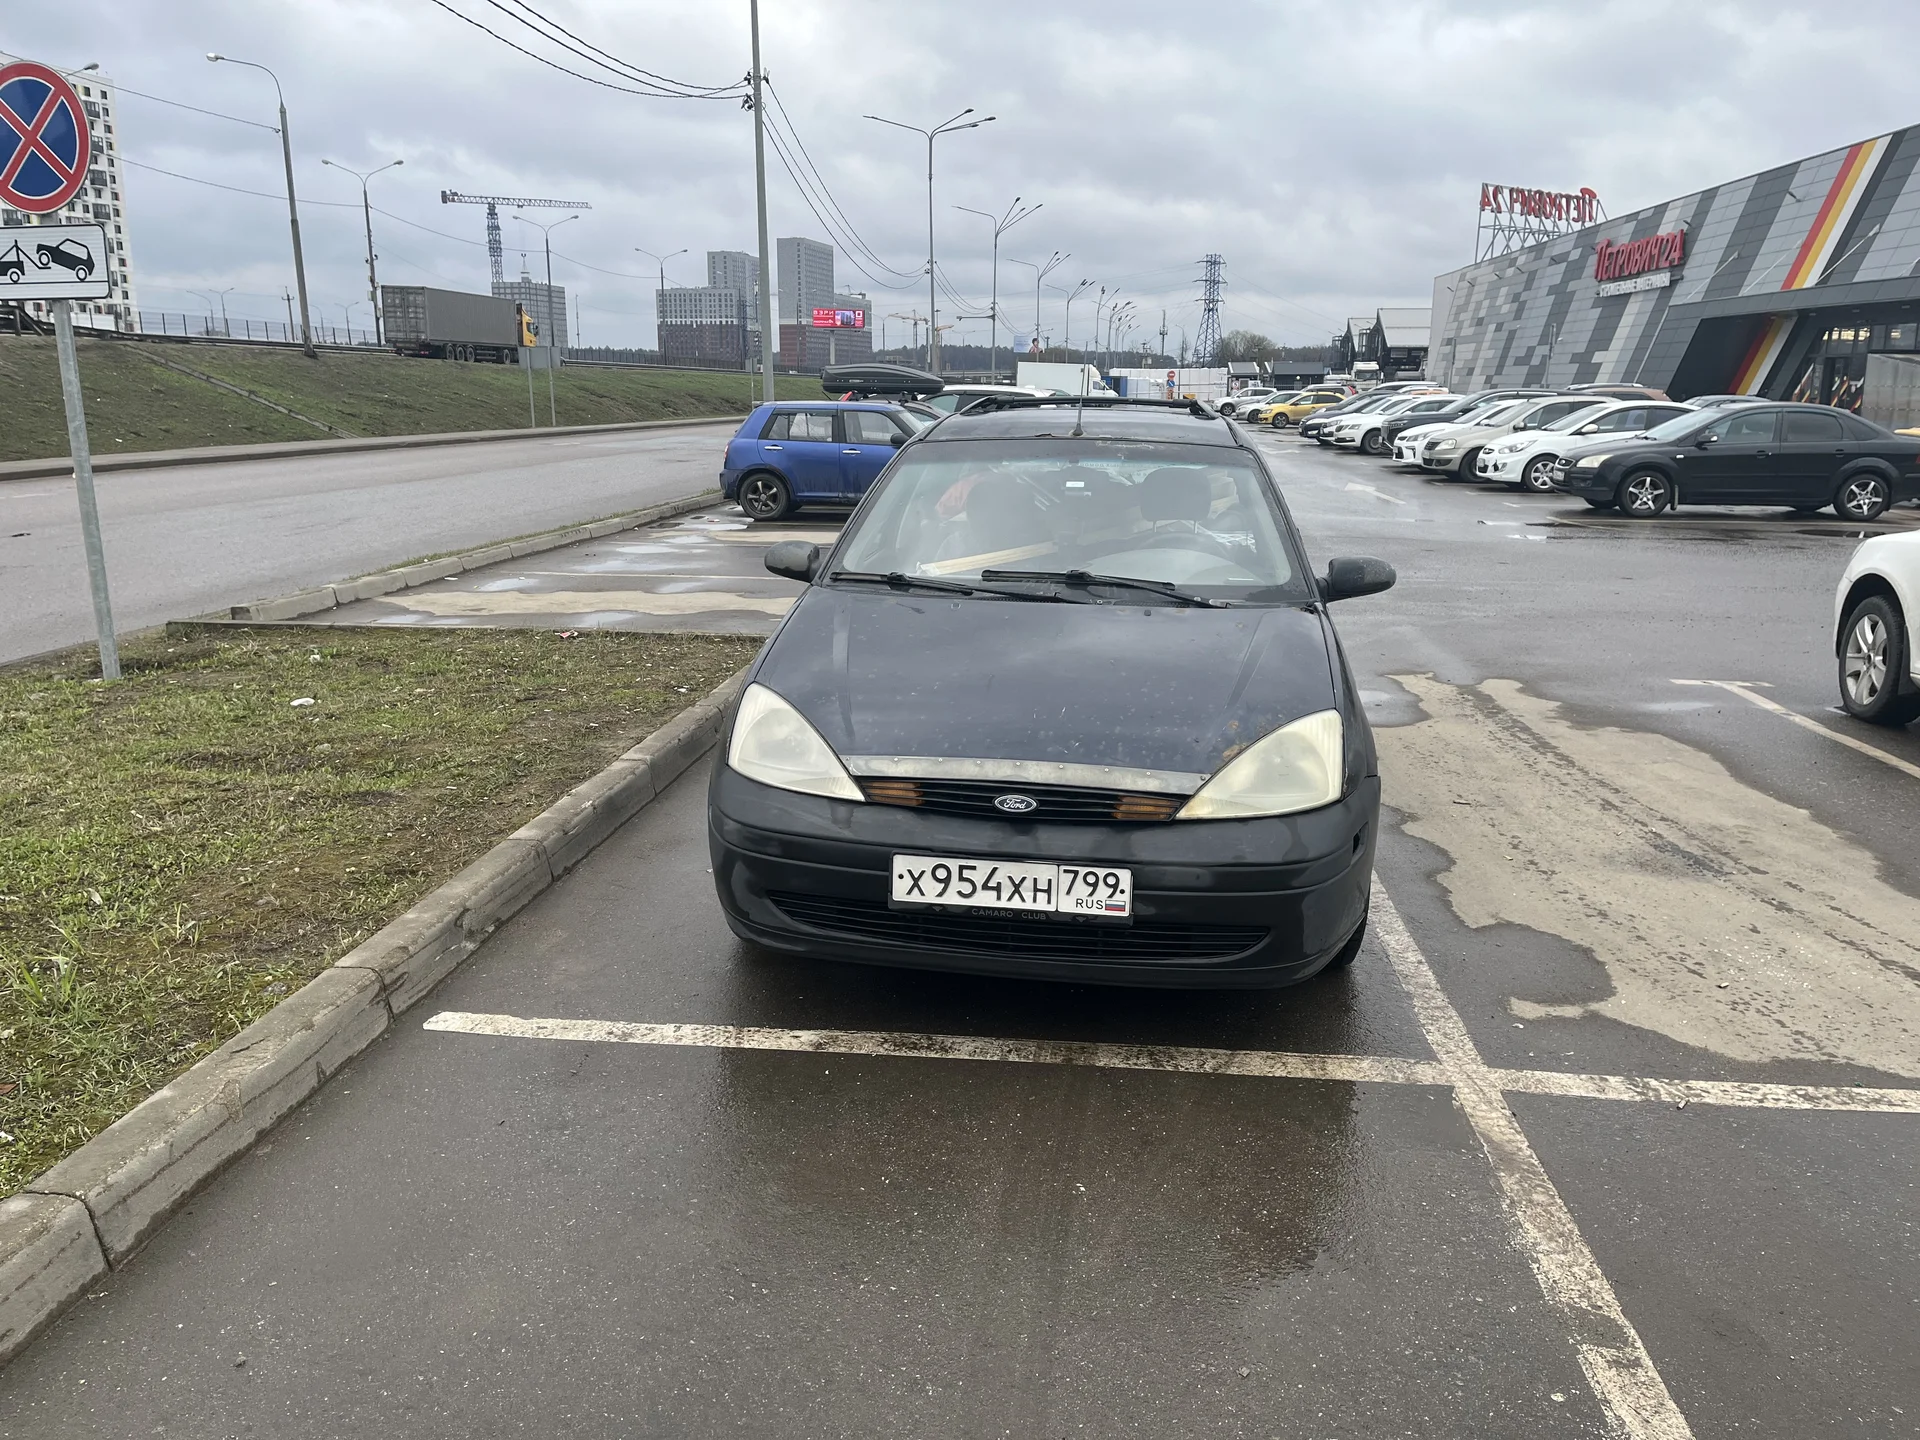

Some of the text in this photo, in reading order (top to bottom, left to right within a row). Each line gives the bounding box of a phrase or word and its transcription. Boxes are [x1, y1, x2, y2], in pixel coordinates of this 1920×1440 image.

[1003, 797, 1027, 809] Ford
[1063, 869, 1121, 898] 799
[1075, 898, 1104, 909] RUS
[971, 908, 1047, 920] CAMARO CLUB
